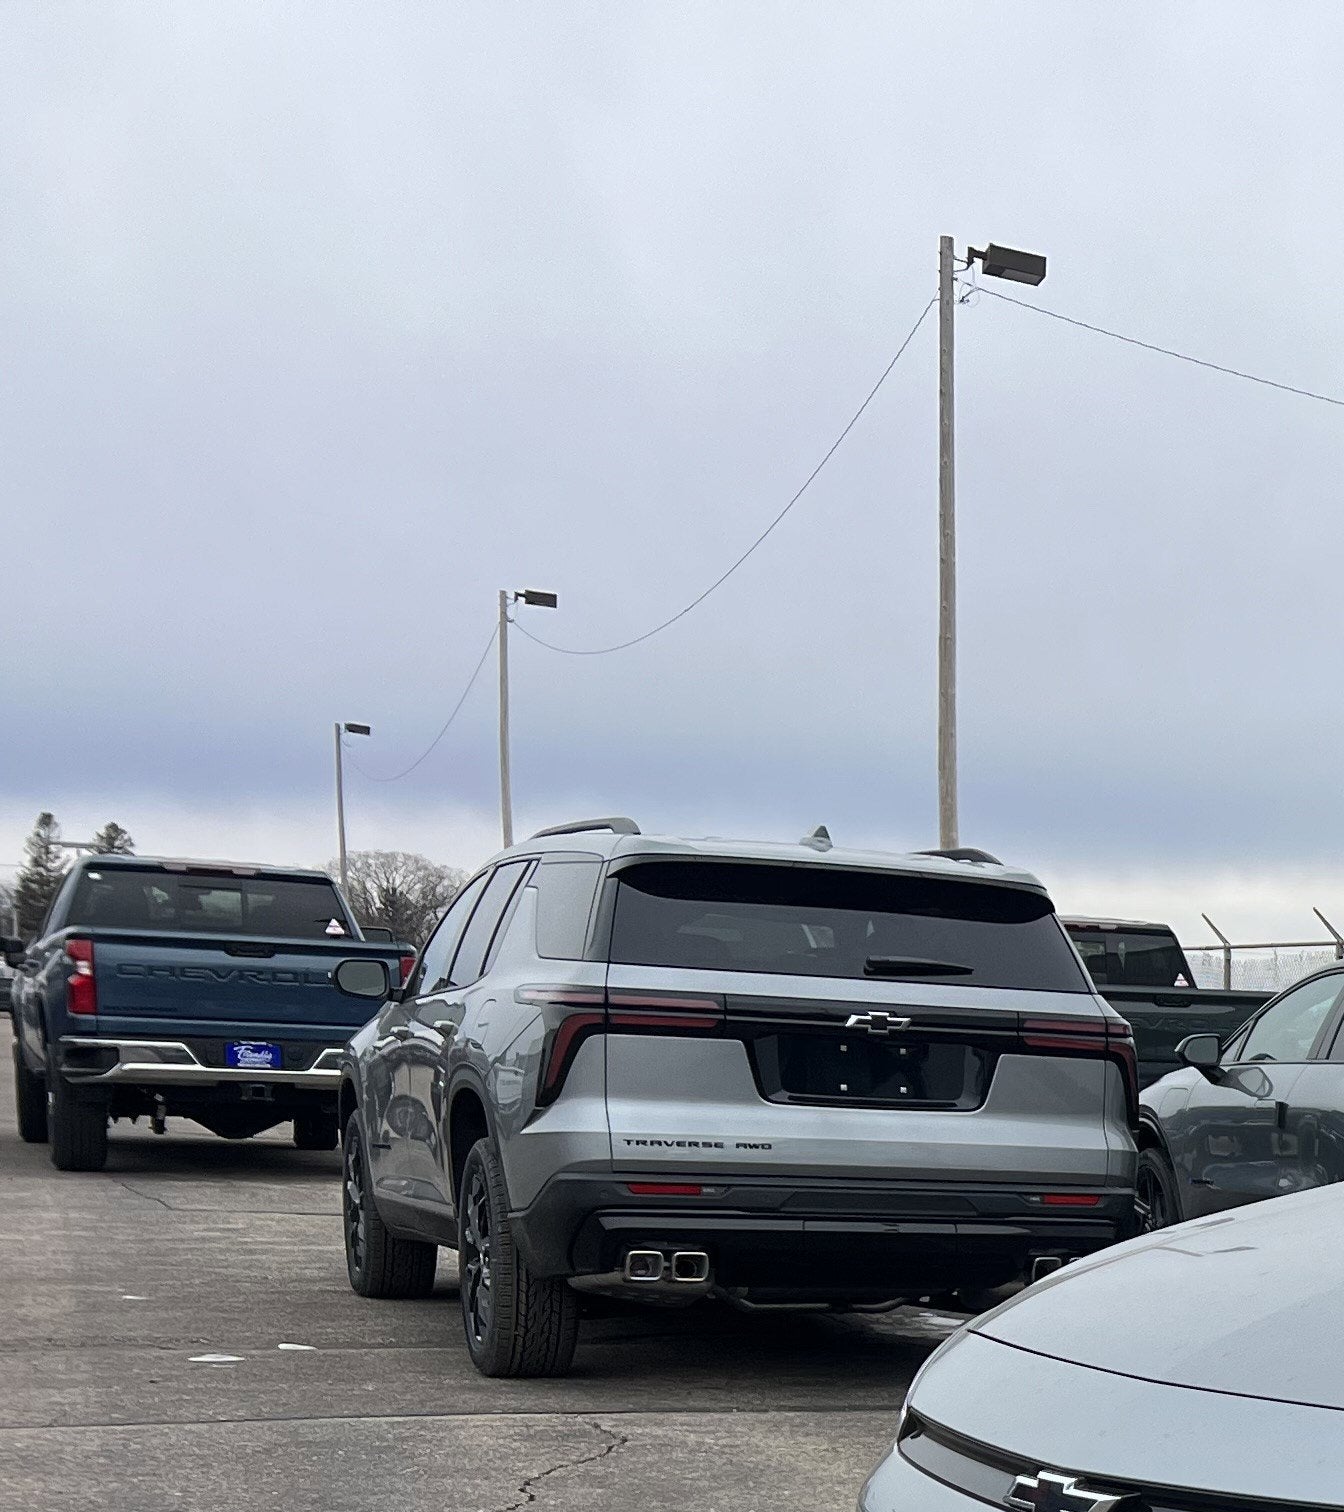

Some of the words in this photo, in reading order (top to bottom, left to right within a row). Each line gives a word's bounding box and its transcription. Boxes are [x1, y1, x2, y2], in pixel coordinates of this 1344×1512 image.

[115, 961, 337, 988] CHEVROL
[622, 1138, 725, 1149] TRAVERSE
[735, 1142, 773, 1150] AWD
